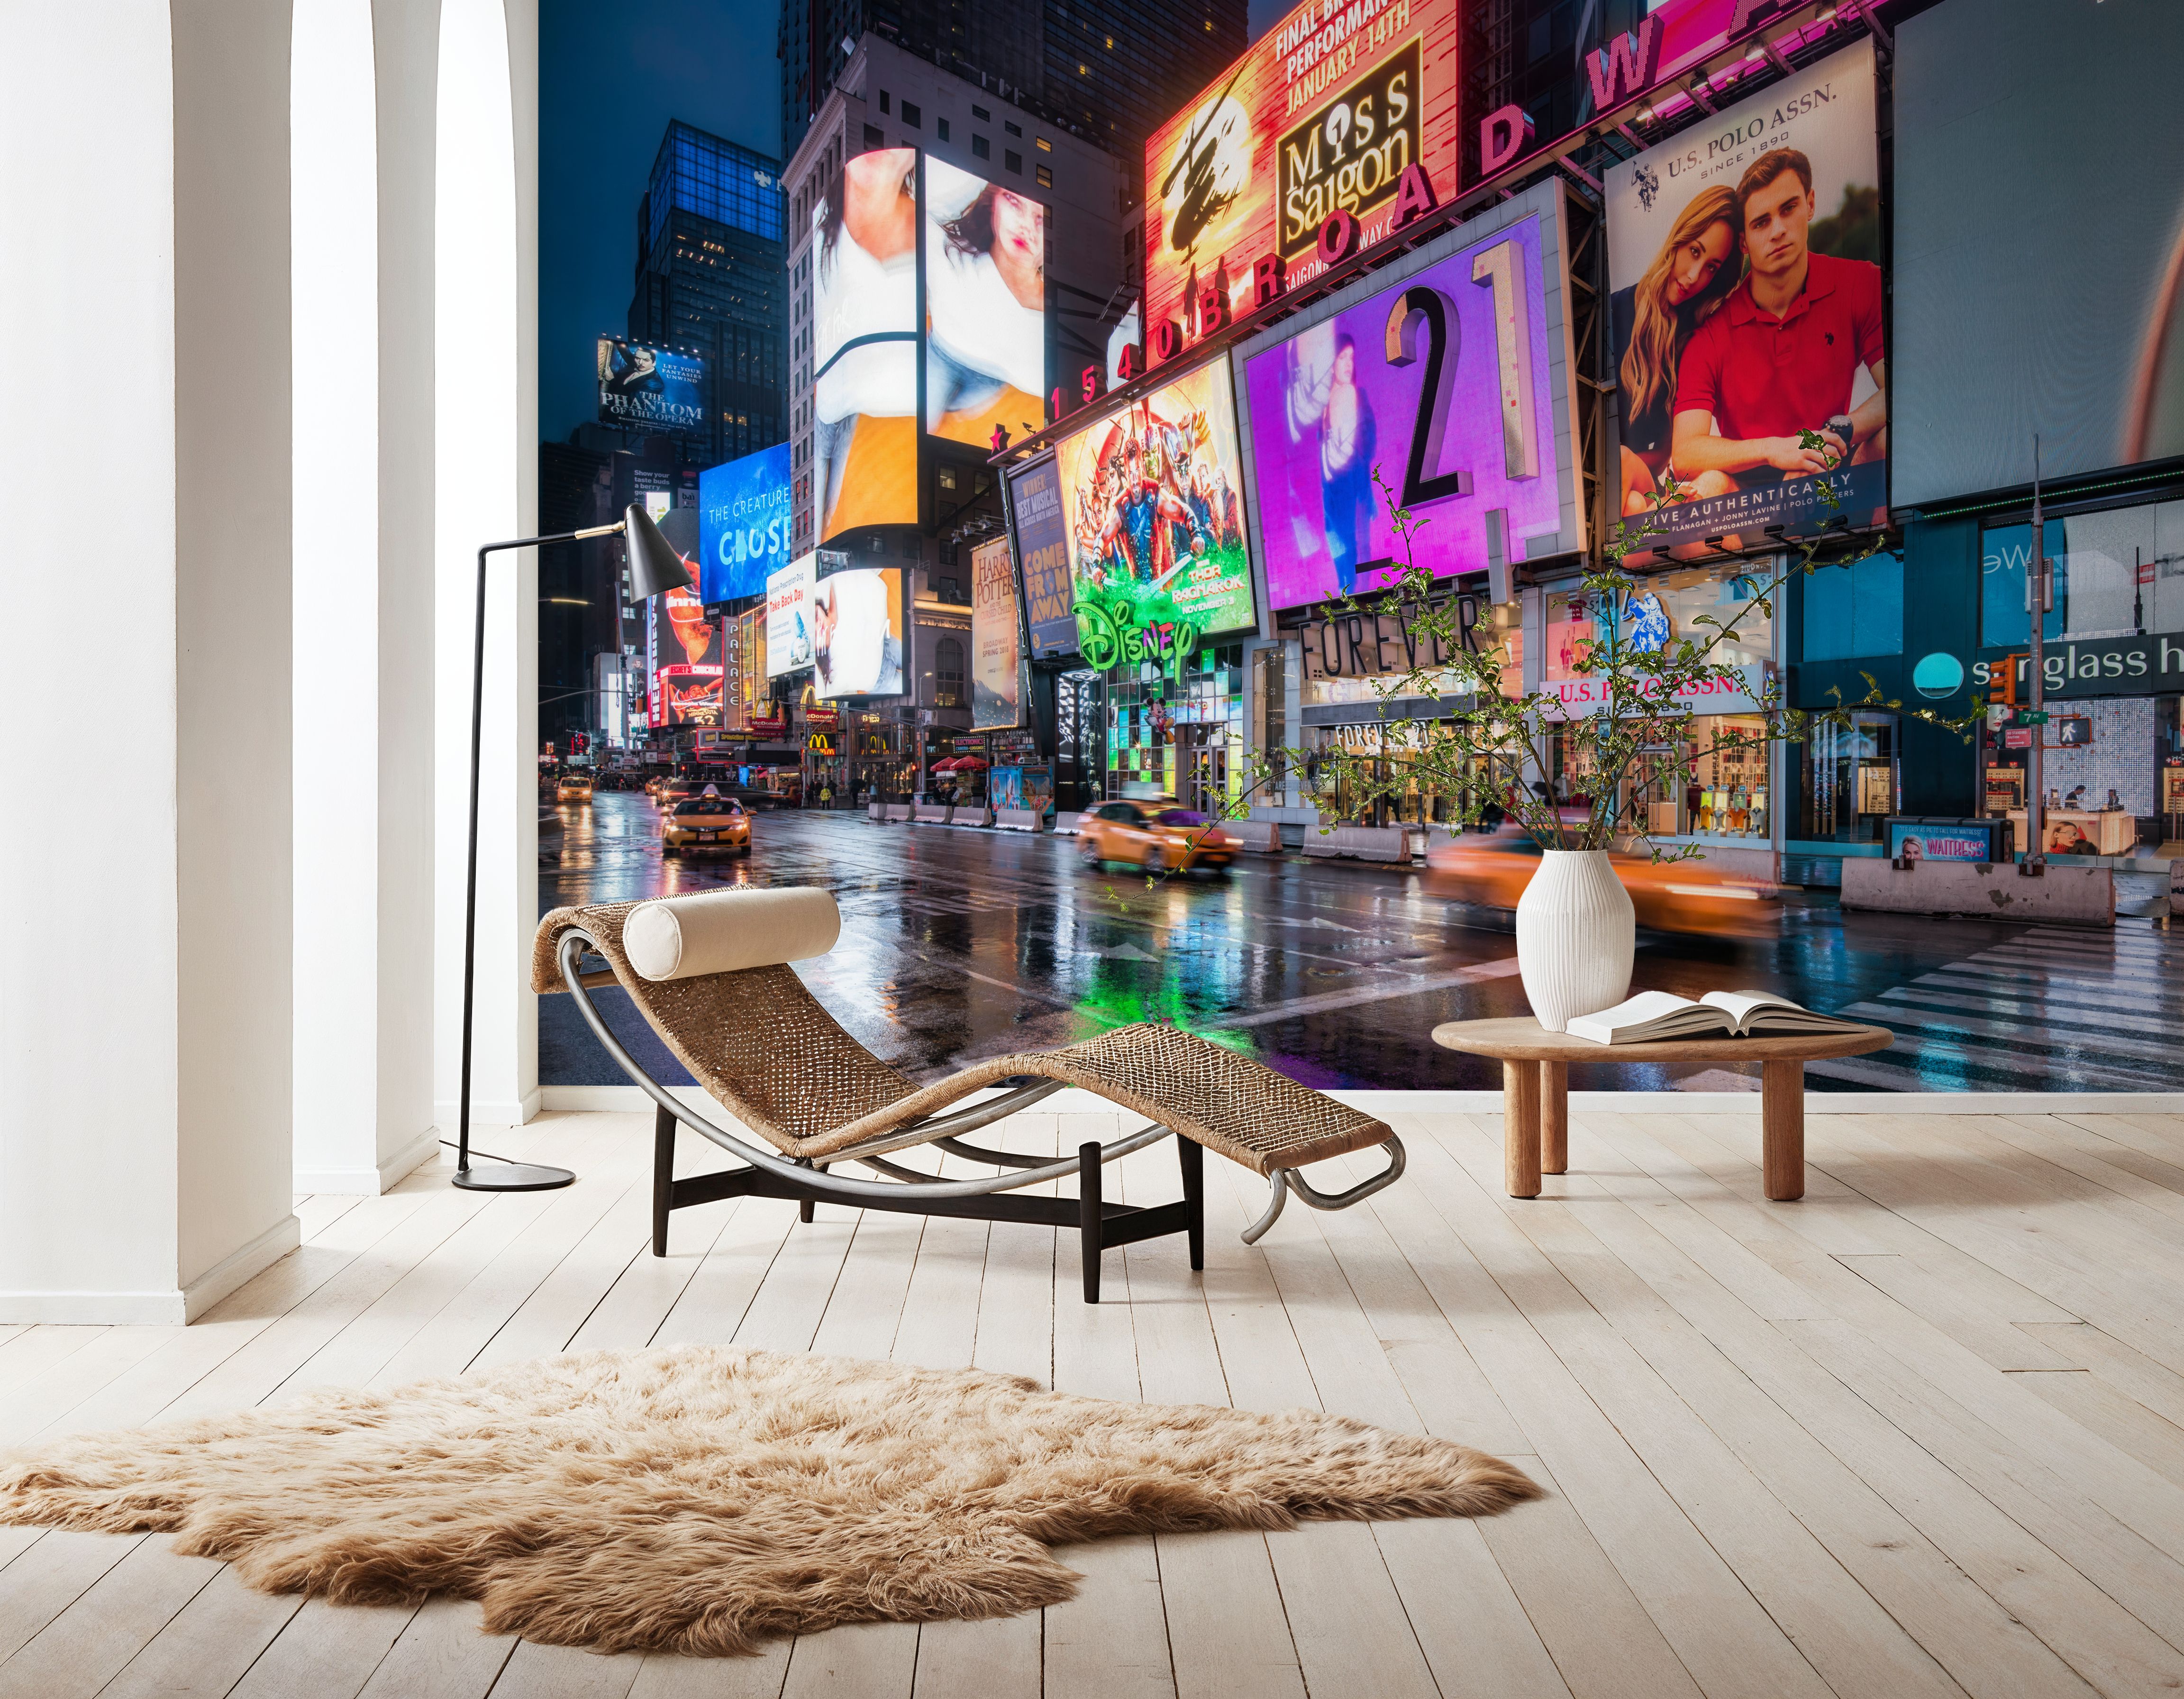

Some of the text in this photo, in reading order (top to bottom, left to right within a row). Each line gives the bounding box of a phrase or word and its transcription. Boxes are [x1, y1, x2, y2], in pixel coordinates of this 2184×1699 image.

[1276, 6, 1318, 62] FINAL
[1286, 0, 1410, 118] JANUARY 14TH
[1667, 82, 1837, 178] U.S. POLO ASSN.
[1700, 131, 1789, 180] SINCE 1890
[662, 368, 702, 380] FANTASIES
[666, 374, 697, 383] UNWIND
[1051, 318, 1174, 420] 1540
[1385, 239, 1538, 511] 21
[601, 392, 703, 420] PHANTOM
[640, 391, 664, 402] THE
[610, 406, 694, 426] OF THE OPERA
[709, 487, 789, 525] THE CREATURE
[1017, 486, 1058, 520] BEST MUSICAL
[1690, 473, 1851, 519] AUTHENTICALY
[1672, 520, 1711, 532] FLANAGAN
[1722, 510, 1749, 522] JONNY
[1752, 504, 1781, 516] LAVINE
[1790, 497, 1813, 508] POLO
[1817, 489, 1855, 502] PLERS
[1711, 516, 1770, 533] USPOLOASSN.COM
[978, 552, 1011, 583] HARRY
[1024, 541, 1066, 575] COME
[1189, 565, 1221, 584] THOR
[770, 589, 803, 613] Take Back Day
[976, 574, 1015, 609] POTTER
[1172, 575, 1245, 604] RAGNAROK
[998, 604, 1012, 615] CHILD
[1031, 591, 1069, 624] AWAY
[1182, 596, 1234, 614] NOVEMBER 3
[983, 637, 1009, 649] BROADWAY
[983, 646, 1009, 658] SPRING 2018
[729, 625, 739, 706] PALACE
[1559, 683, 1595, 703] U.S.
[2024, 713, 2032, 722] 7
[1275, 781, 1285, 790] ARE
[1926, 837, 1984, 858] WAITRESS
